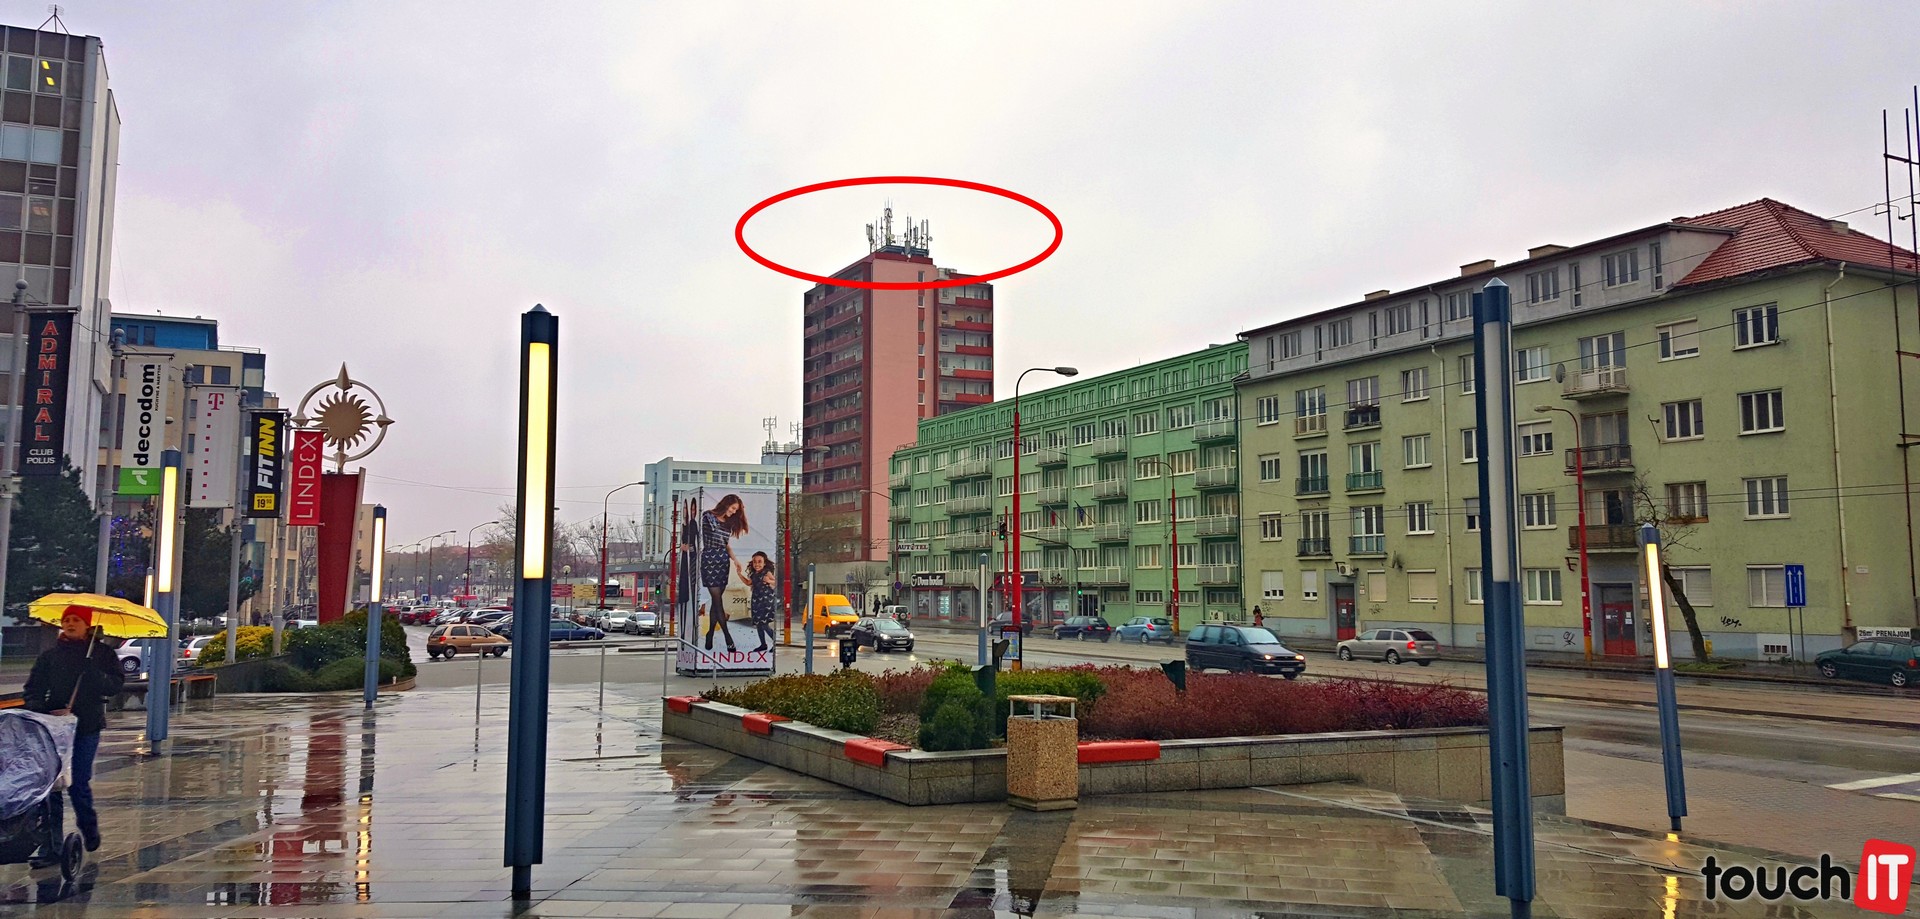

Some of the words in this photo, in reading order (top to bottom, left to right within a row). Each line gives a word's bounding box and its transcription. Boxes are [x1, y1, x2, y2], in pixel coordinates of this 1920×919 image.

[32, 319, 59, 442] ADMIRAL
[133, 364, 155, 466] decodom
[29, 448, 54, 456] CLUB
[297, 436, 318, 519] LINDEX
[702, 651, 768, 664] LINDEX
